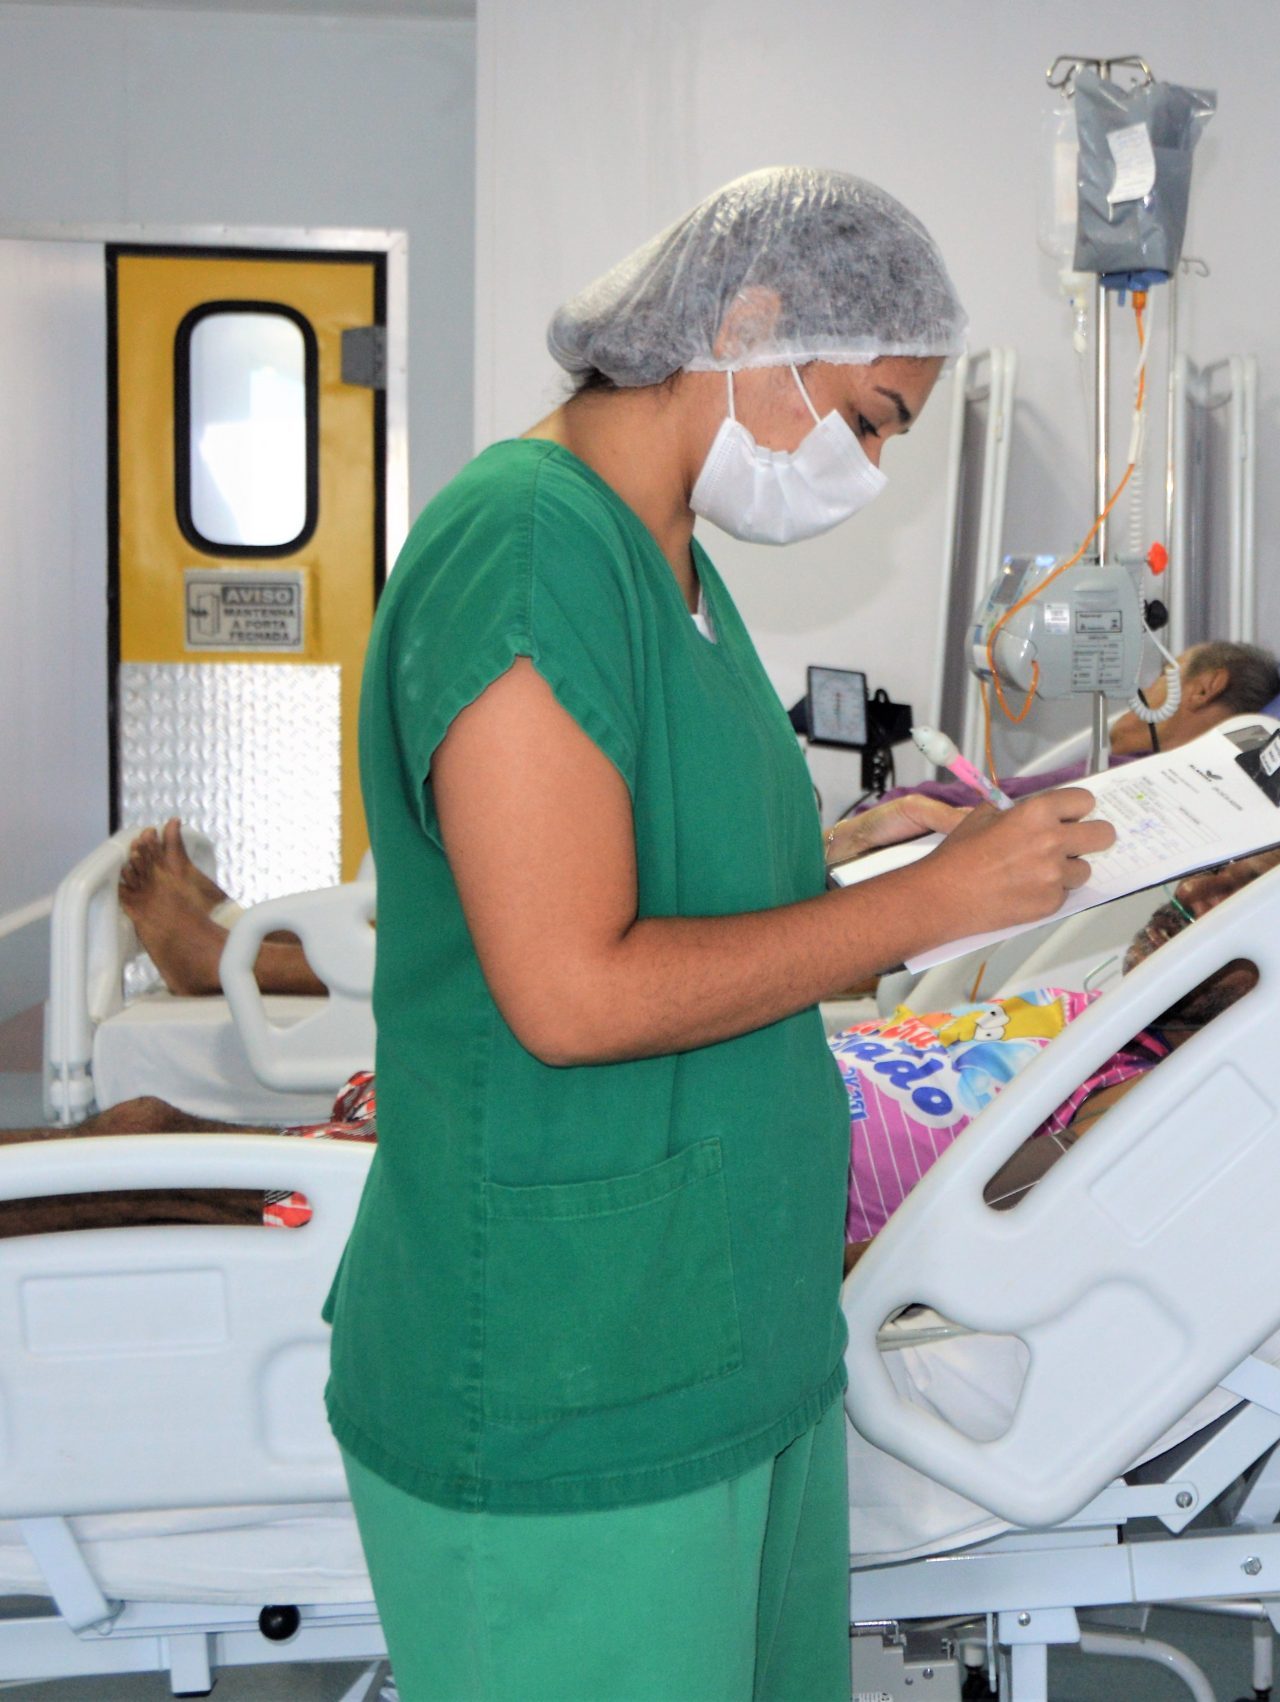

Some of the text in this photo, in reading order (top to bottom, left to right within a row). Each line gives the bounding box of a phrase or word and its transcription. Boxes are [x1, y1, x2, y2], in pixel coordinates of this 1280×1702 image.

[226, 588, 290, 602] AVISO
[223, 608, 294, 618] MANTENHA
[233, 620, 287, 630] A PORTA
[229, 631, 289, 642] FECHADA
